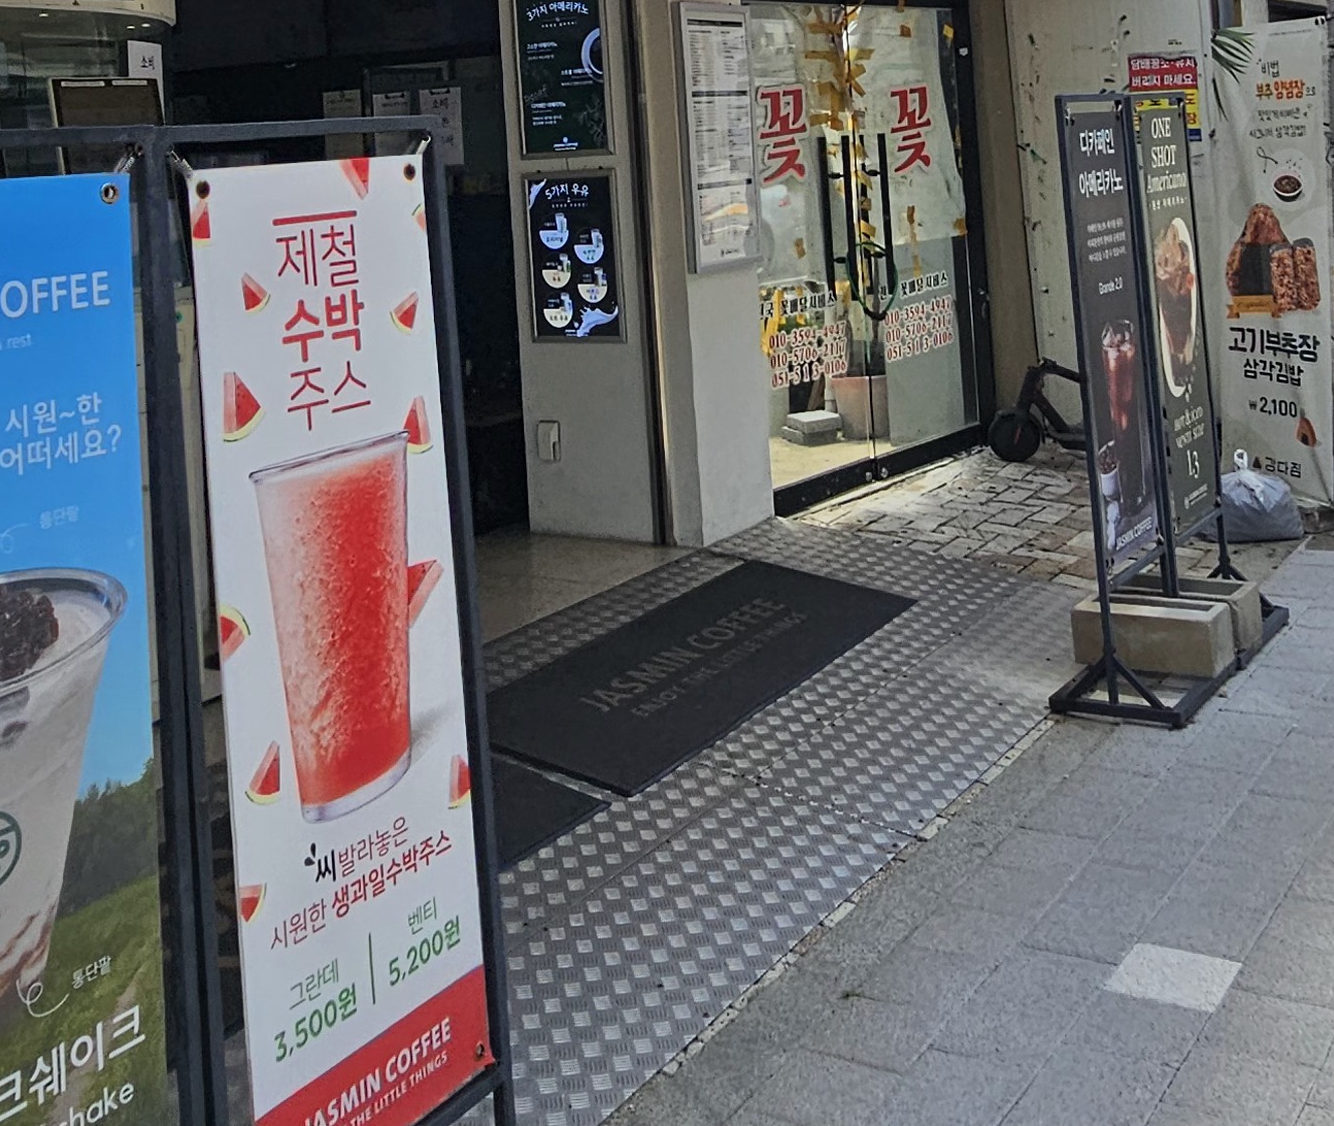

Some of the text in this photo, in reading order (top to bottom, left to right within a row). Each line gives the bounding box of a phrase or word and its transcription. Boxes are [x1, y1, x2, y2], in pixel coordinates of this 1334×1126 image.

[526, 0, 589, 21] 3가지 아메리카노
[1132, 75, 1160, 86] 버리지
[1261, 60, 1279, 77] 비법
[760, 88, 807, 183] 꽃
[890, 86, 931, 173] 꽃
[1080, 128, 1115, 156] 디카페인
[1151, 117, 1171, 138] ONE
[1151, 145, 1176, 169] SHOT
[545, 183, 589, 200] 5가지 우유
[1079, 168, 1123, 198] 아메리카노
[276, 224, 359, 287] 제철
[282, 289, 364, 362] 수박
[1228, 327, 1320, 363] 고기부추장
[287, 361, 371, 430] 주스
[1243, 358, 1304, 387] 삼각김밥
[4, 392, 102, 439] 시원~한
[1264, 457, 1302, 477] 강다짐
[1134, 517, 1152, 537] COFFEE
[579, 598, 786, 713] JASMIN COFFEE
[270, 830, 453, 950] 시원한 생과일수박주스
[408, 897, 438, 935] 벤티
[388, 916, 462, 986] 5,200원
[289, 958, 339, 1010] 그란데
[274, 982, 358, 1063] 3,500원
[386, 1017, 451, 1084] COFFEE
[57, 1080, 134, 1126] hake
[374, 1082, 407, 1114] LITTLE
[410, 1050, 447, 1087] THINGS
